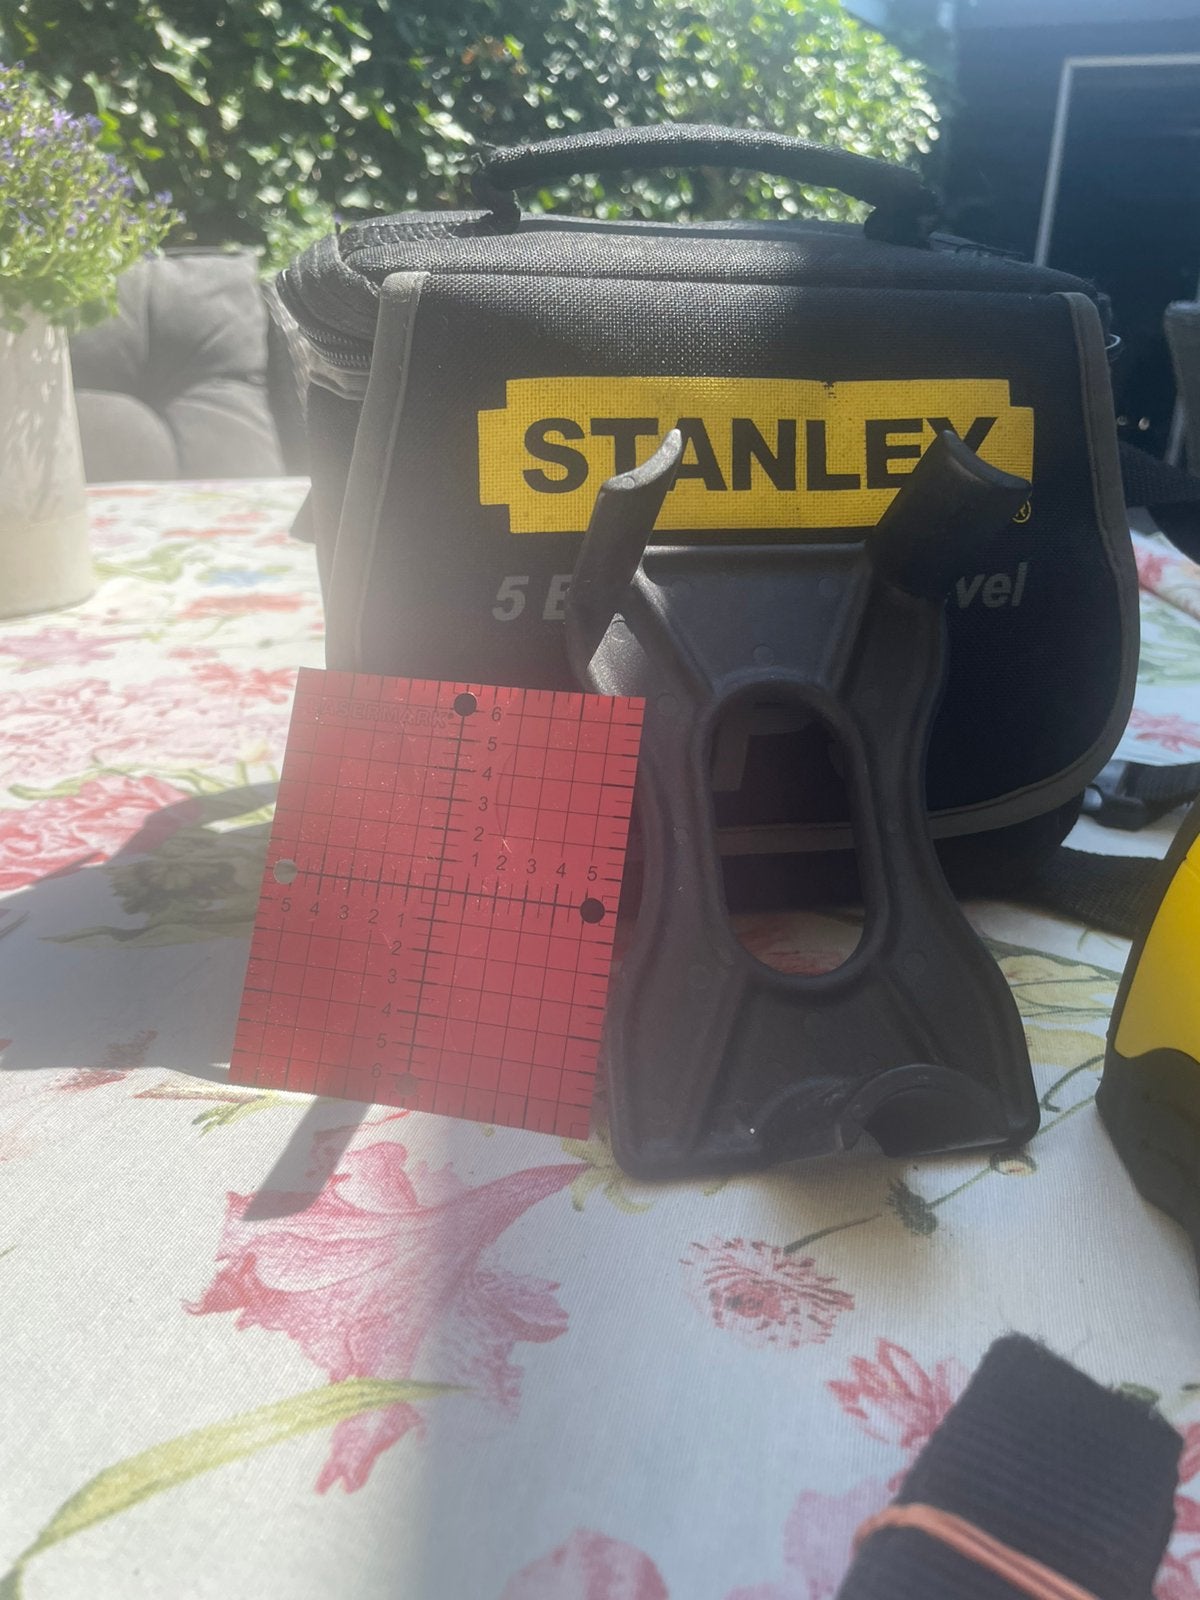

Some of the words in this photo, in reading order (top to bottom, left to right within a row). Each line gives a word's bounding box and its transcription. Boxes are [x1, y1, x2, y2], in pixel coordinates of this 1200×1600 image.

[522, 416, 998, 494] STANLEY
[491, 574, 531, 622] 5
[954, 561, 1030, 610] vel
[491, 706, 502, 722] 6
[487, 736, 498, 751] 5
[481, 766, 492, 781] 4
[478, 796, 488, 811] 3
[473, 826, 485, 842] 2
[472, 851, 479, 867] 1
[496, 855, 507, 871] 2
[526, 858, 537, 874] 3
[556, 862, 566, 878] 4
[587, 865, 598, 882] 5
[281, 897, 292, 912] 5
[310, 901, 320, 916] 4
[338, 905, 349, 920] 3
[368, 908, 379, 924] 2
[398, 913, 404, 928] 1
[391, 940, 402, 956] 2
[387, 968, 398, 984] 3
[381, 1001, 392, 1017] 4
[376, 1032, 387, 1048] 5
[371, 1062, 383, 1079] 6
